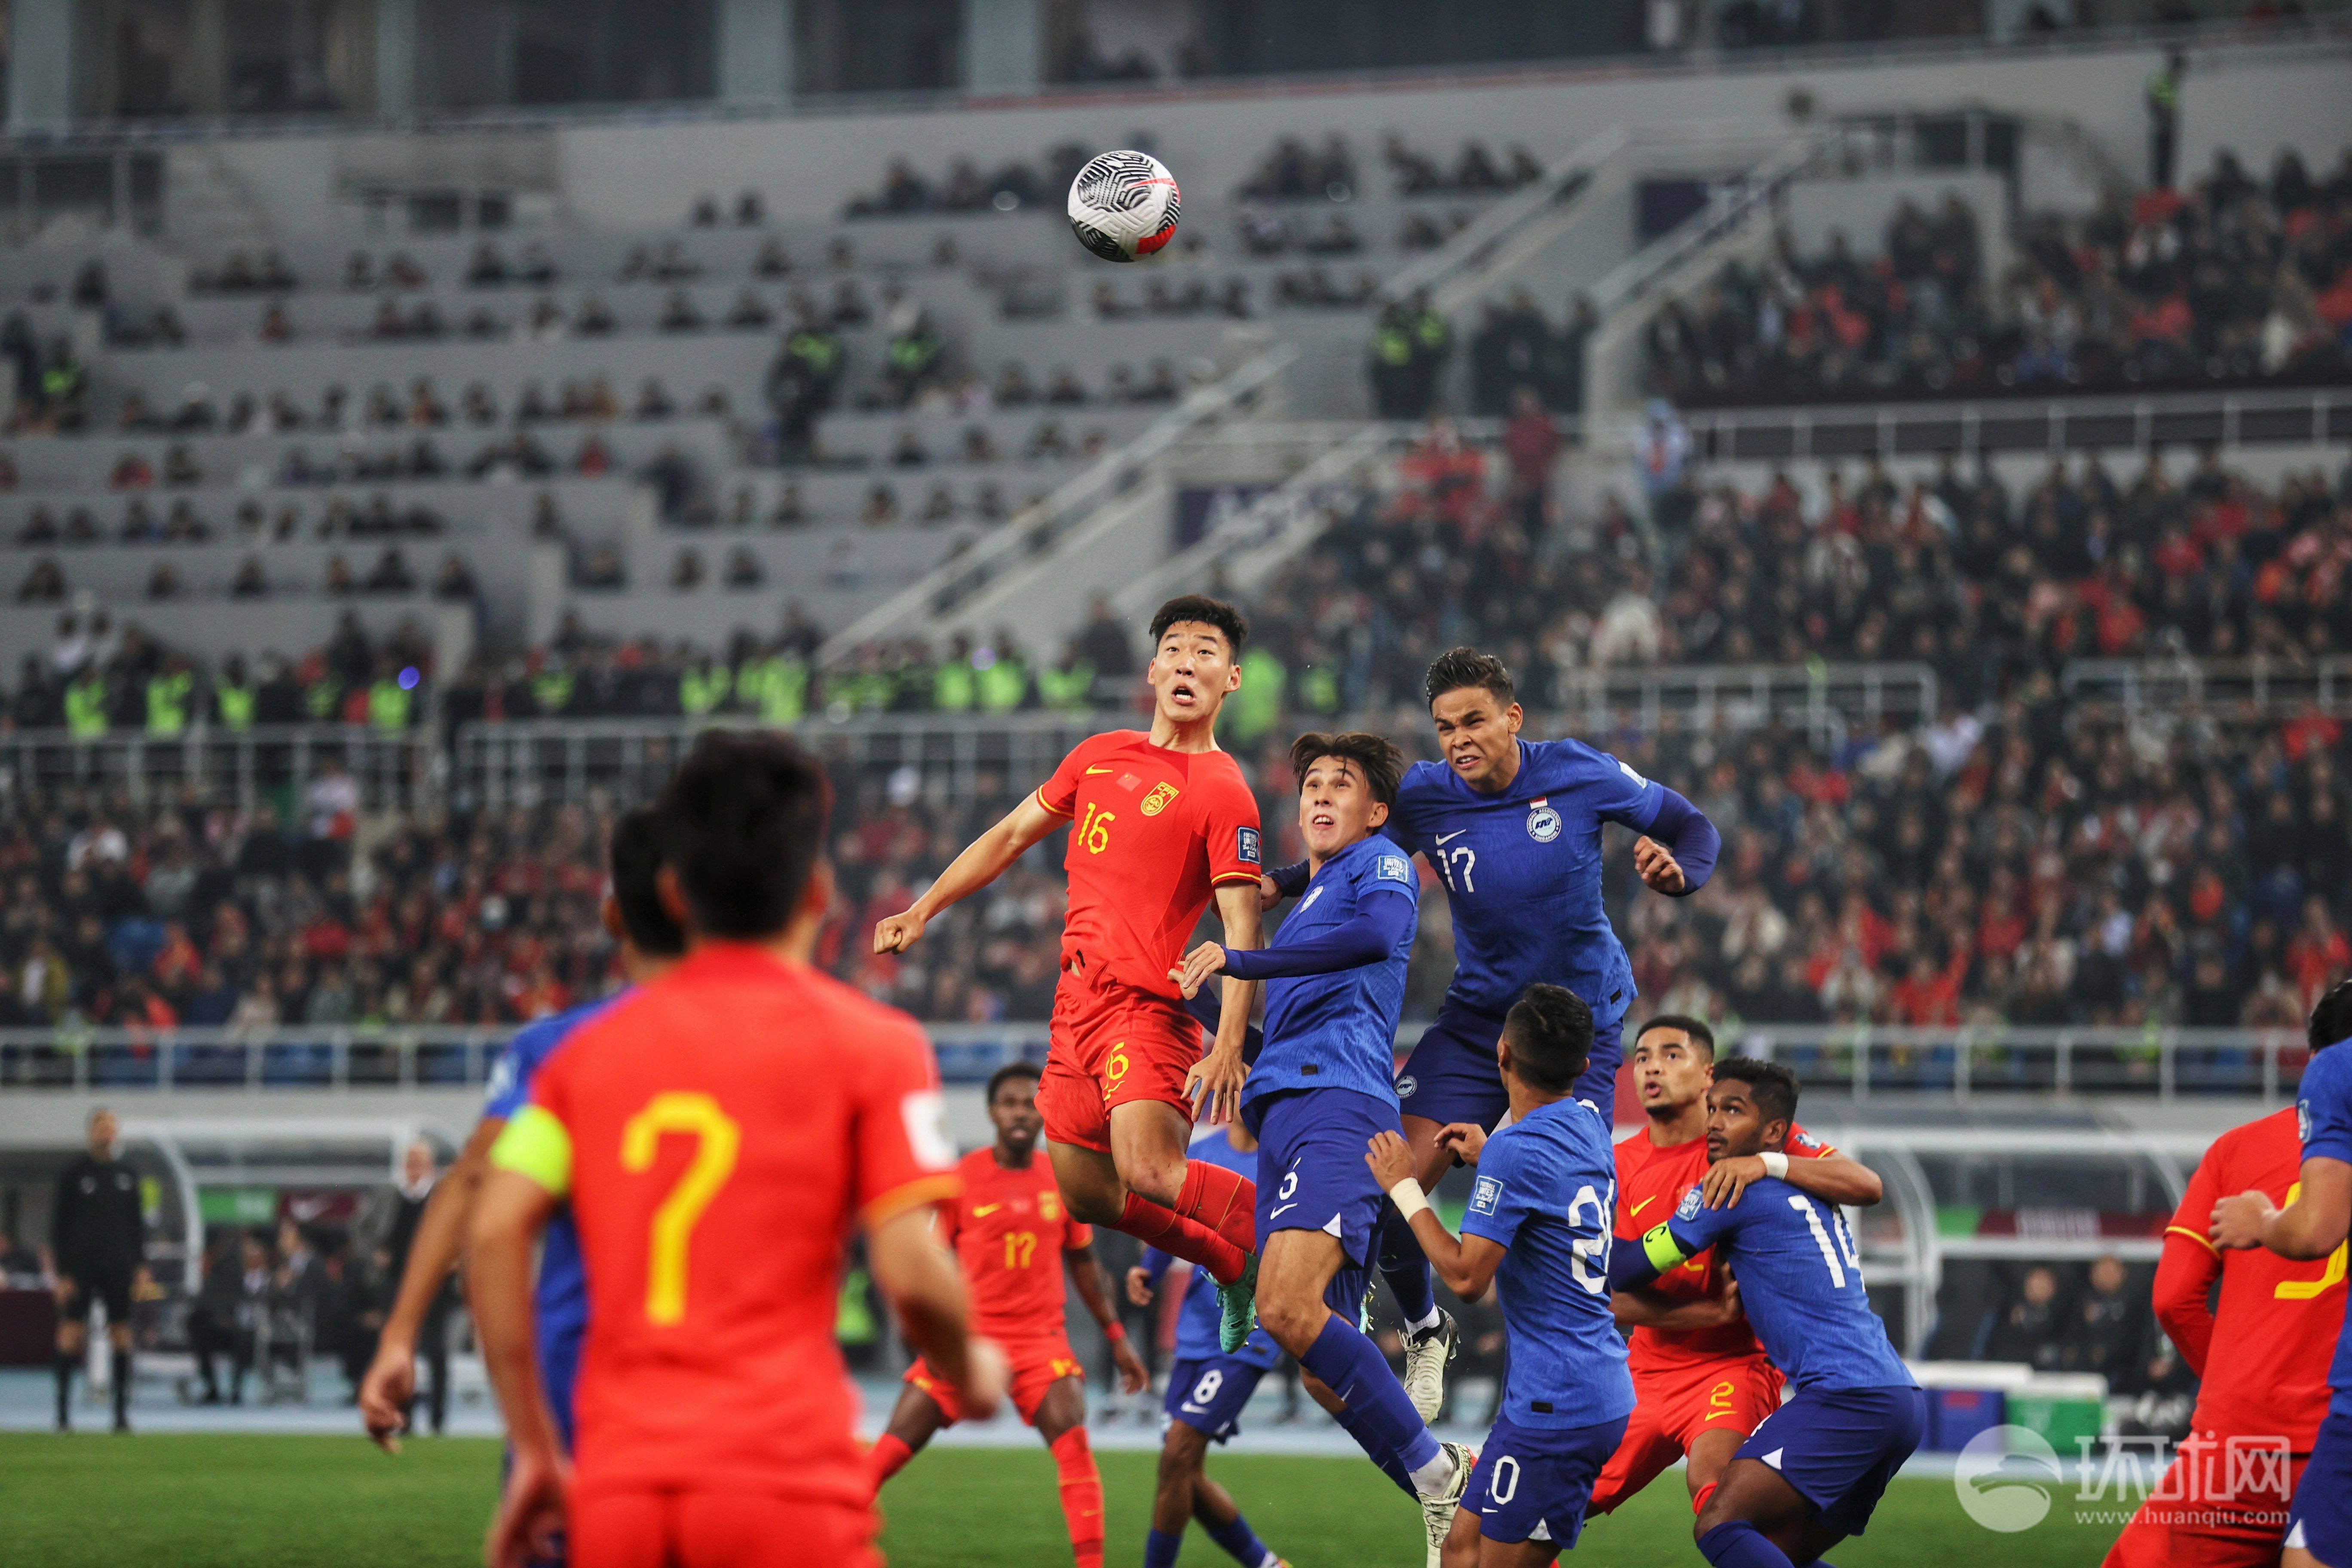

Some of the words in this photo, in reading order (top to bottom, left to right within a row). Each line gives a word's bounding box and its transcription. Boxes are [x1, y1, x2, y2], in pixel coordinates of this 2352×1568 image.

[1078, 802, 1116, 854] 16
[1437, 846, 1475, 893] 17
[619, 1090, 741, 1327] 7
[1004, 1231, 1037, 1269] 17
[1645, 1226, 1666, 1243] C
[1193, 1369, 1223, 1404] 8
[1710, 1381, 1735, 1408] 2
